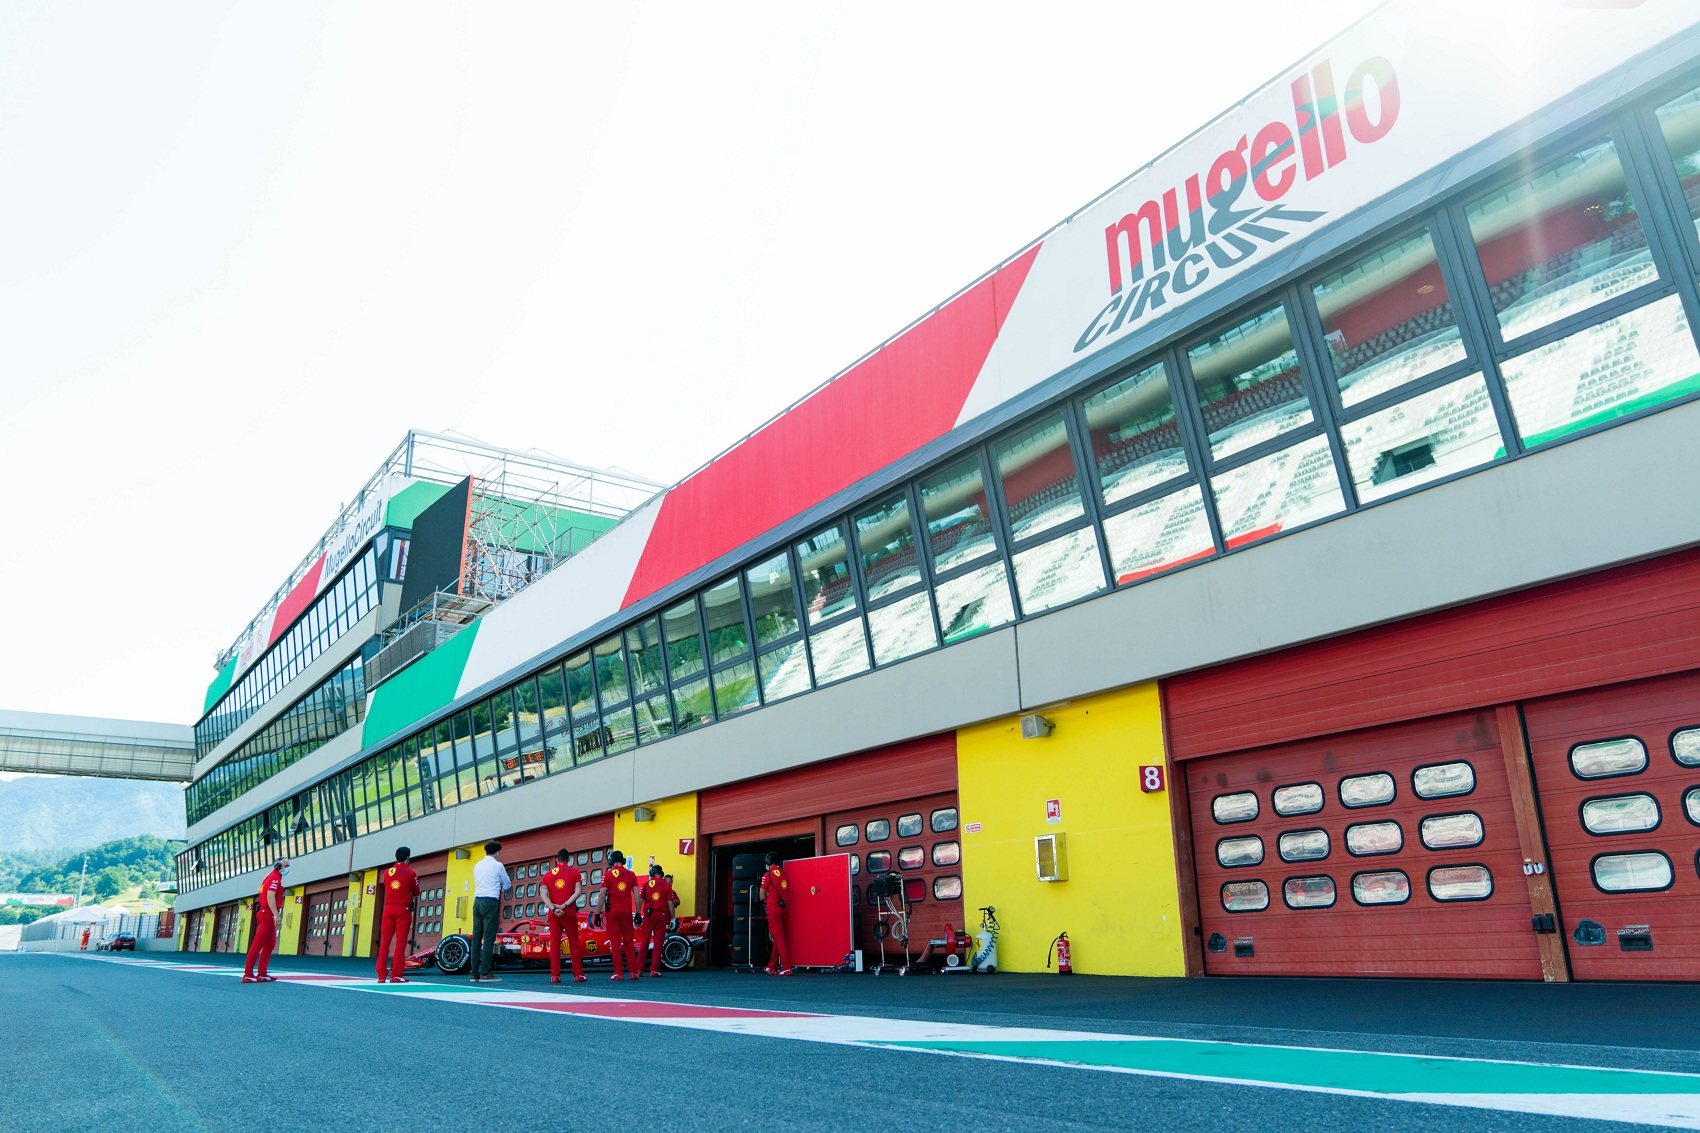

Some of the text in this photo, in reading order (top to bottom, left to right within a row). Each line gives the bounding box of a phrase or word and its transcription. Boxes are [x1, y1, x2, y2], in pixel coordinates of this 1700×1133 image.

[1105, 56, 1400, 297] mugello
[1073, 204, 1329, 353] CIRCUIT
[1145, 767, 1160, 790] 8
[682, 839, 692, 854] 7
[367, 886, 375, 894] 5
[295, 896, 302, 904] 4
[587, 943, 597, 952] ups
